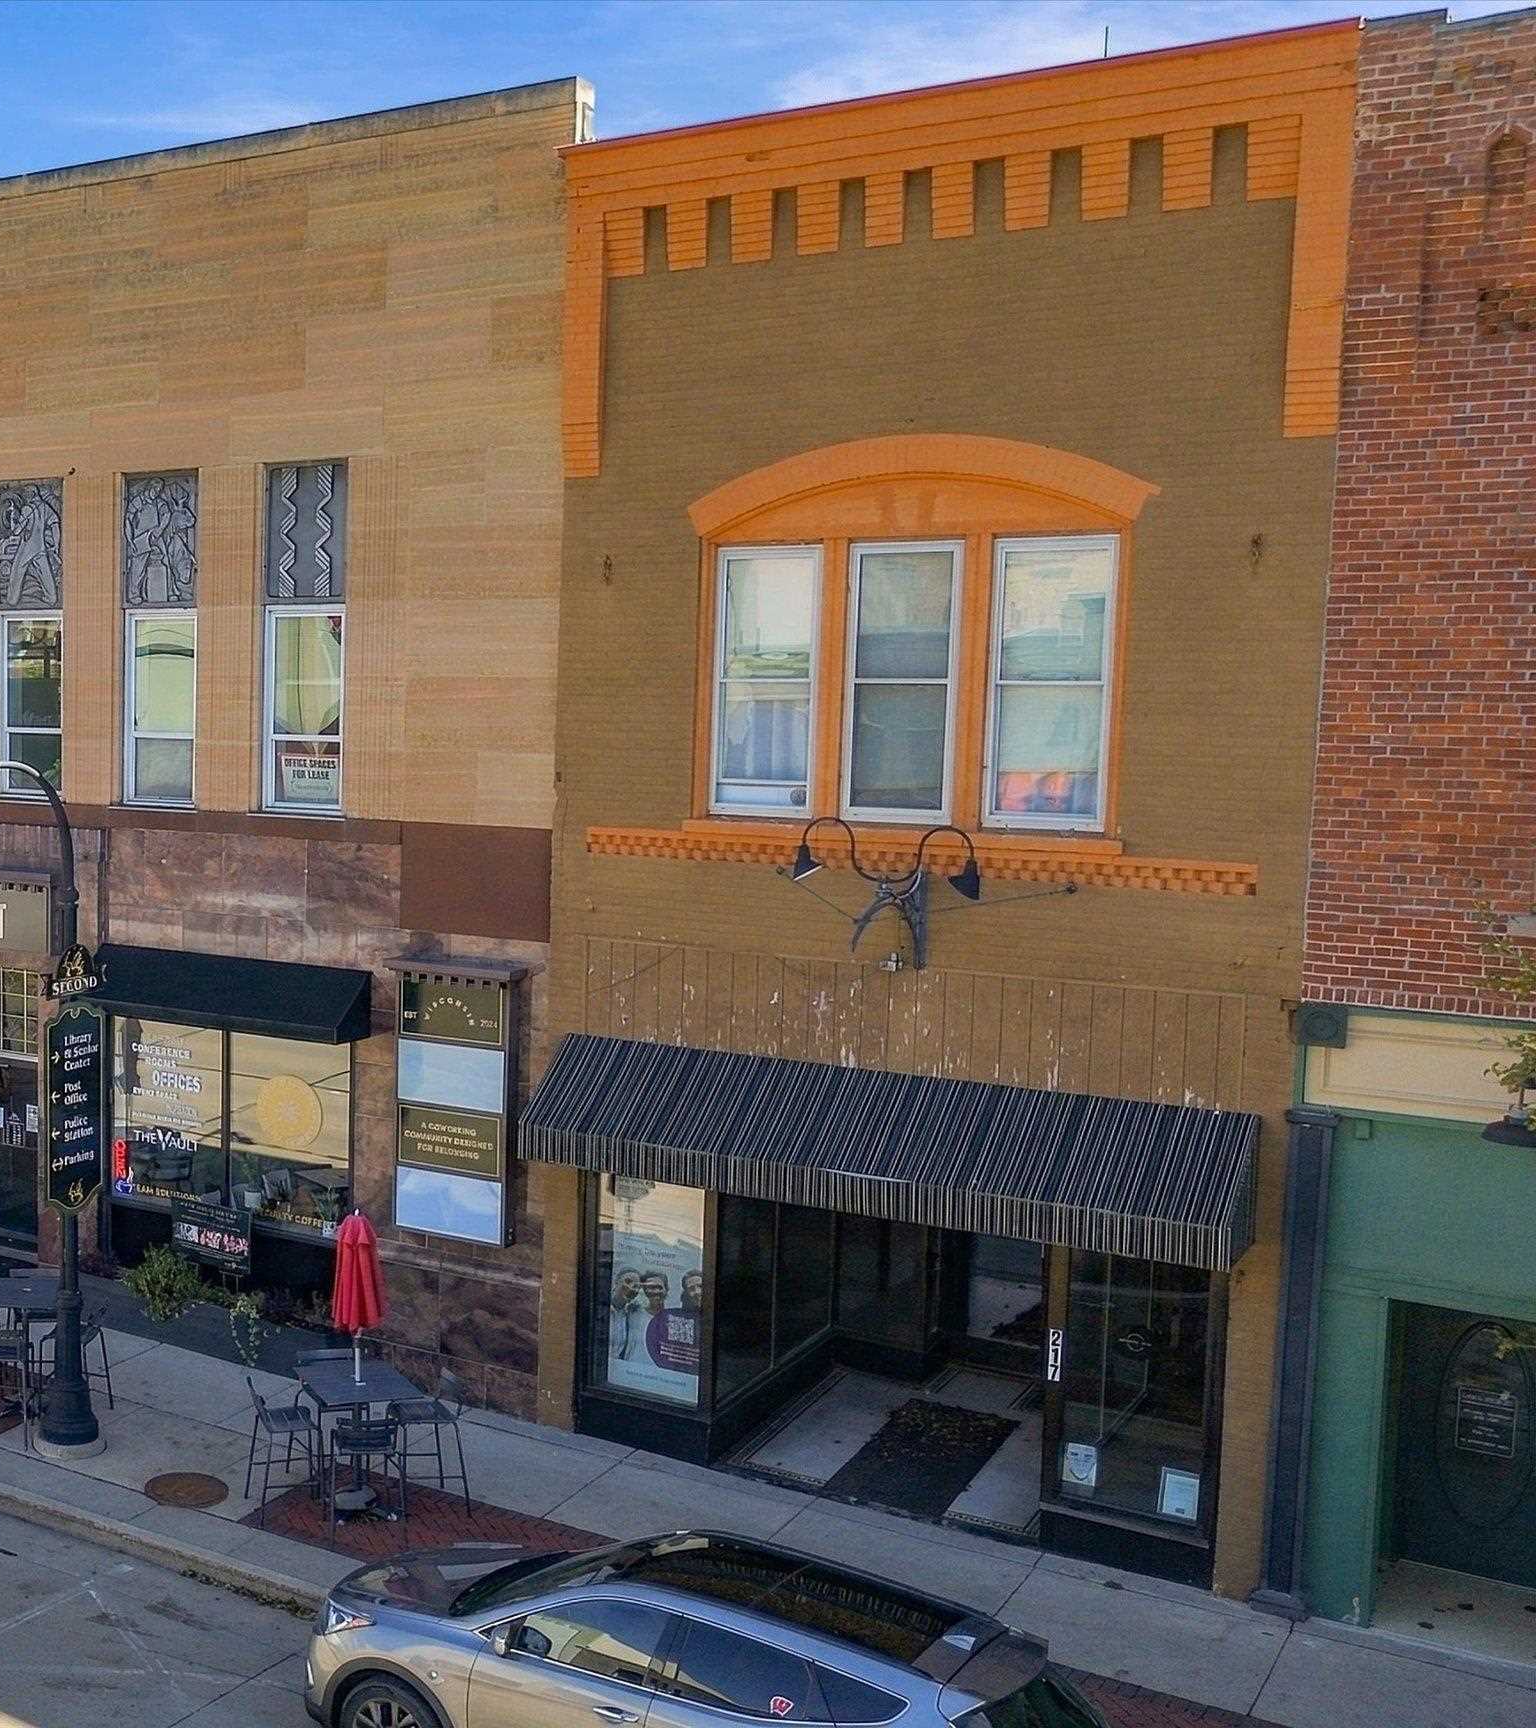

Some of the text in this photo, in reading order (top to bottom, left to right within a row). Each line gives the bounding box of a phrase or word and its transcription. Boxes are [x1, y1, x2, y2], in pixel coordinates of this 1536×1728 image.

[284, 758, 308, 768] OFFICE
[292, 769, 330, 780] FOR LEASE
[52, 975, 98, 996] SECOND
[64, 1032, 93, 1047] Library
[73, 1043, 99, 1058] Senior
[131, 1042, 191, 1060] CONFERENCE
[64, 1057, 92, 1072] Center
[64, 1080, 82, 1093] Post
[152, 1069, 202, 1093] OFFICES
[64, 1092, 88, 1106] Office
[64, 1116, 89, 1130] Police
[428, 1122, 477, 1137] COWORKING
[64, 1127, 94, 1143] Station
[133, 1129, 199, 1152] THE VAULT
[404, 1129, 494, 1151] COMMUNITY DESIGNED
[64, 1150, 95, 1166] Parking
[416, 1142, 480, 1160] FOR BELONGING
[294, 1215, 324, 1227] COFFE
[1050, 1330, 1061, 1380] 217
